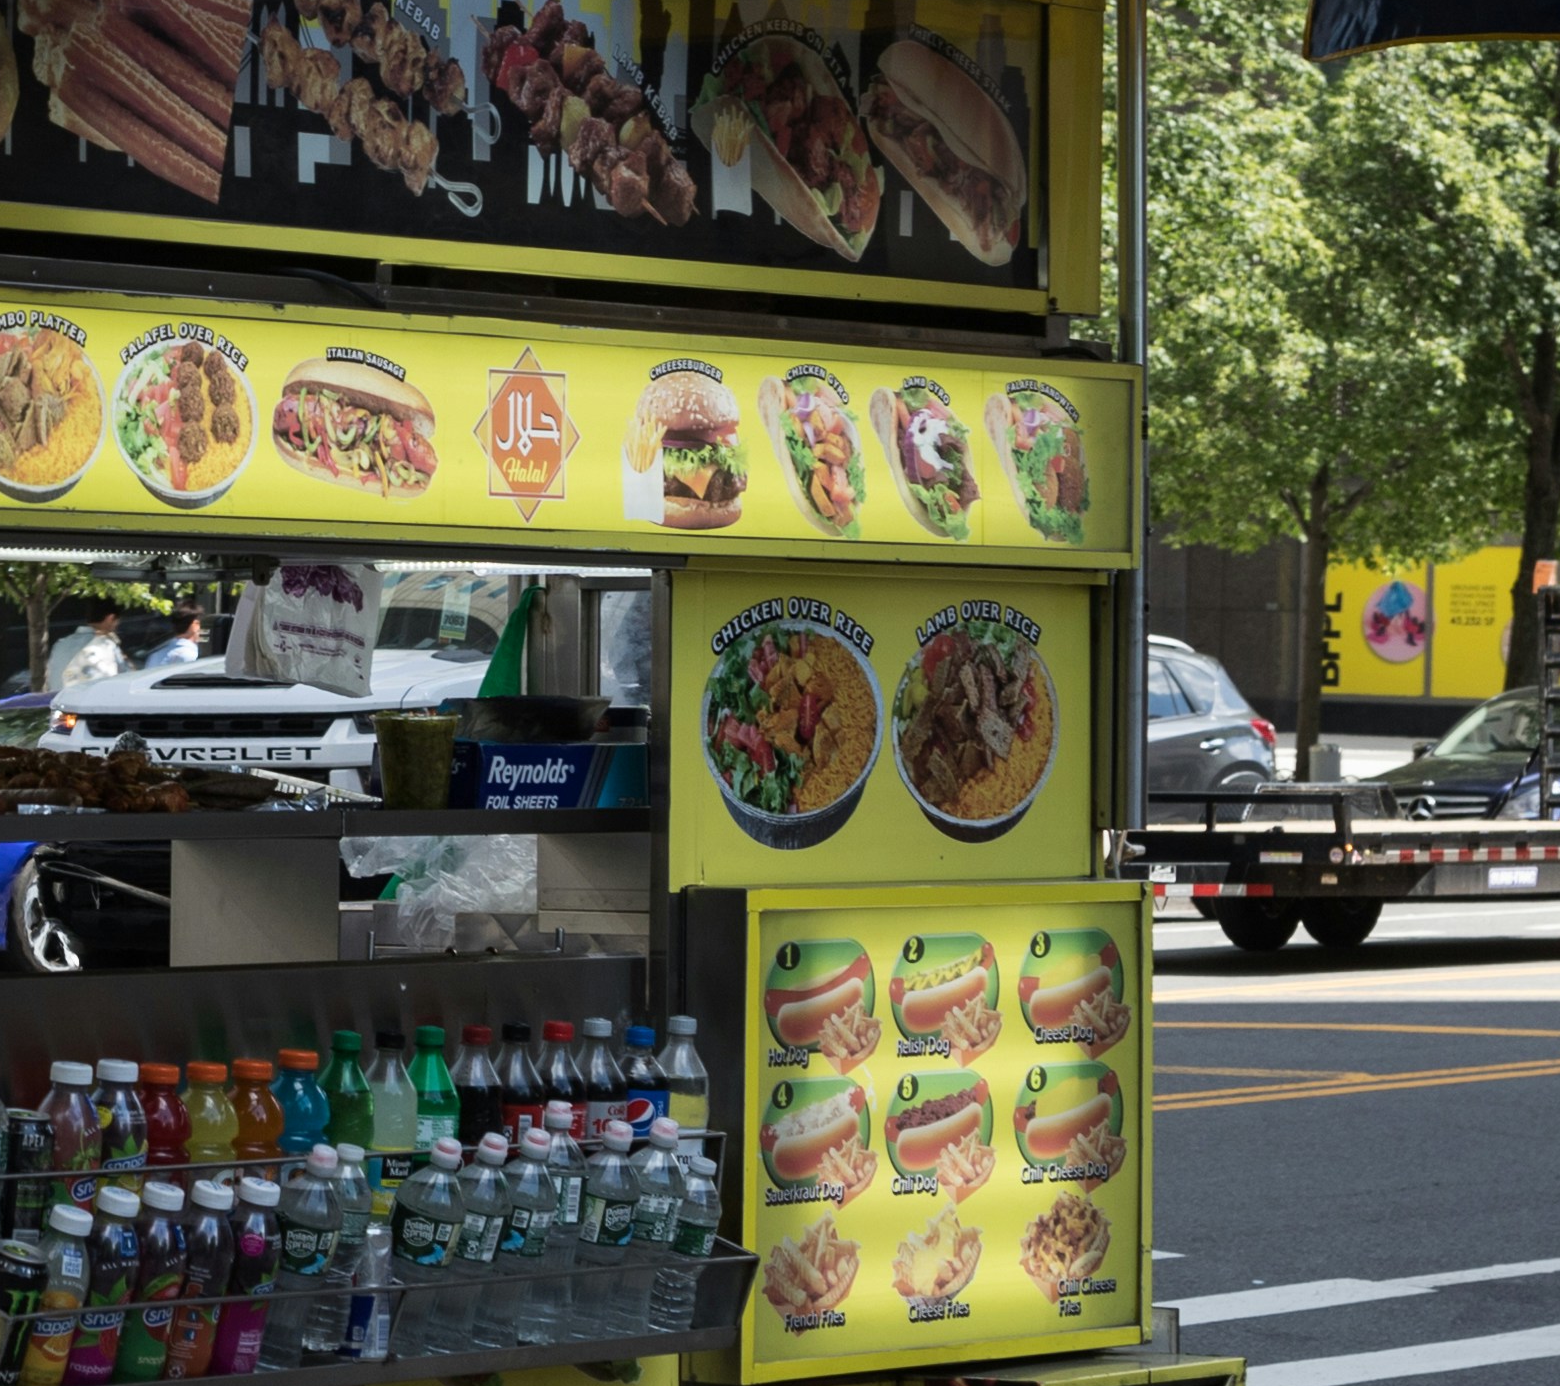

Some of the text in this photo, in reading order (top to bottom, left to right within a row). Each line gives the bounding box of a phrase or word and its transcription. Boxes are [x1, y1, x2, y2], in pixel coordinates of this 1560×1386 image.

[611, 44, 679, 139] LAMB KEBAB
[31, 312, 86, 346] PLATTER
[121, 323, 248, 368] FALAFEL OVER RICE
[327, 348, 405, 380] ITALIAN SAUSAGE
[786, 365, 849, 404] CHICKEN GYRO
[904, 376, 950, 405] LAMB GYRO
[1006, 379, 1079, 422] FALAFEL SANDWICH
[495, 389, 559, 457] حلال
[502, 457, 548, 483] Halal
[712, 597, 875, 655] CHICKEN OVER RICE
[917, 600, 1041, 645] LAMB OVER RICE
[488, 755, 570, 790] Reynolds
[486, 795, 559, 810] FOIL SHEETS
[907, 938, 918, 961] 2
[1035, 931, 1046, 956] 3
[1034, 1025, 1096, 1043] Cheese Dog
[768, 1049, 810, 1067] Hot Dog
[897, 1037, 950, 1057] Relish Dog
[902, 1076, 913, 1100] 5
[1030, 1067, 1042, 1090] 6
[777, 1084, 790, 1107] 4
[22, 1134, 45, 1148] APEX
[1021, 1162, 1109, 1183] Chili Cheese Dog
[765, 1182, 845, 1206] Sauerkraut Dog
[892, 1175, 939, 1196] Chili Dog
[286, 1228, 318, 1242] Poland
[403, 1218, 434, 1233] Poland
[403, 1229, 434, 1242] Spring
[286, 1238, 318, 1250] Spring
[1058, 1277, 1117, 1295] Chili Cheese
[909, 1301, 970, 1322] Cheese Fries
[1058, 1299, 1081, 1318] Fries
[784, 1310, 846, 1332] French Fries
